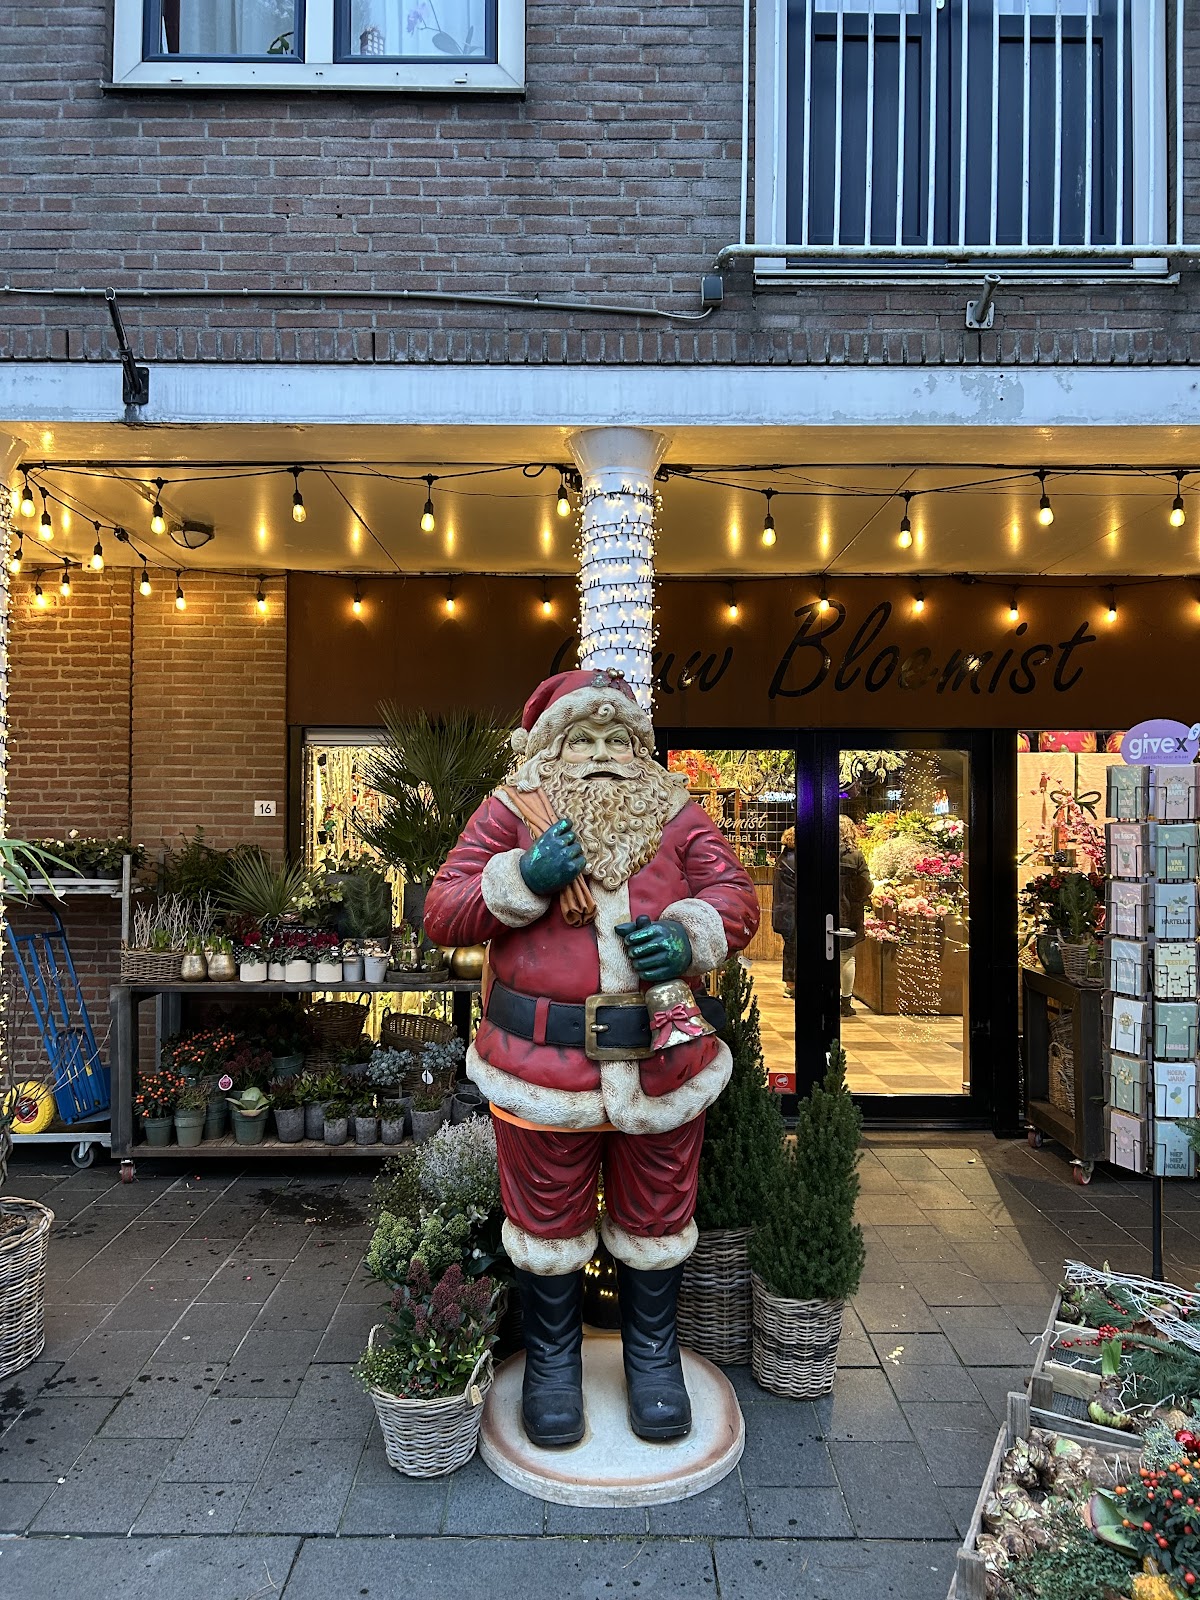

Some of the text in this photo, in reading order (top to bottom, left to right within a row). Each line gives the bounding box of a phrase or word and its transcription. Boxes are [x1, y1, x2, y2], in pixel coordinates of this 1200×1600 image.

[767, 599, 1097, 699] Bloemist
[1129, 733, 1188, 760] givex
[260, 803, 272, 815] 16
[755, 833, 767, 843] 16
